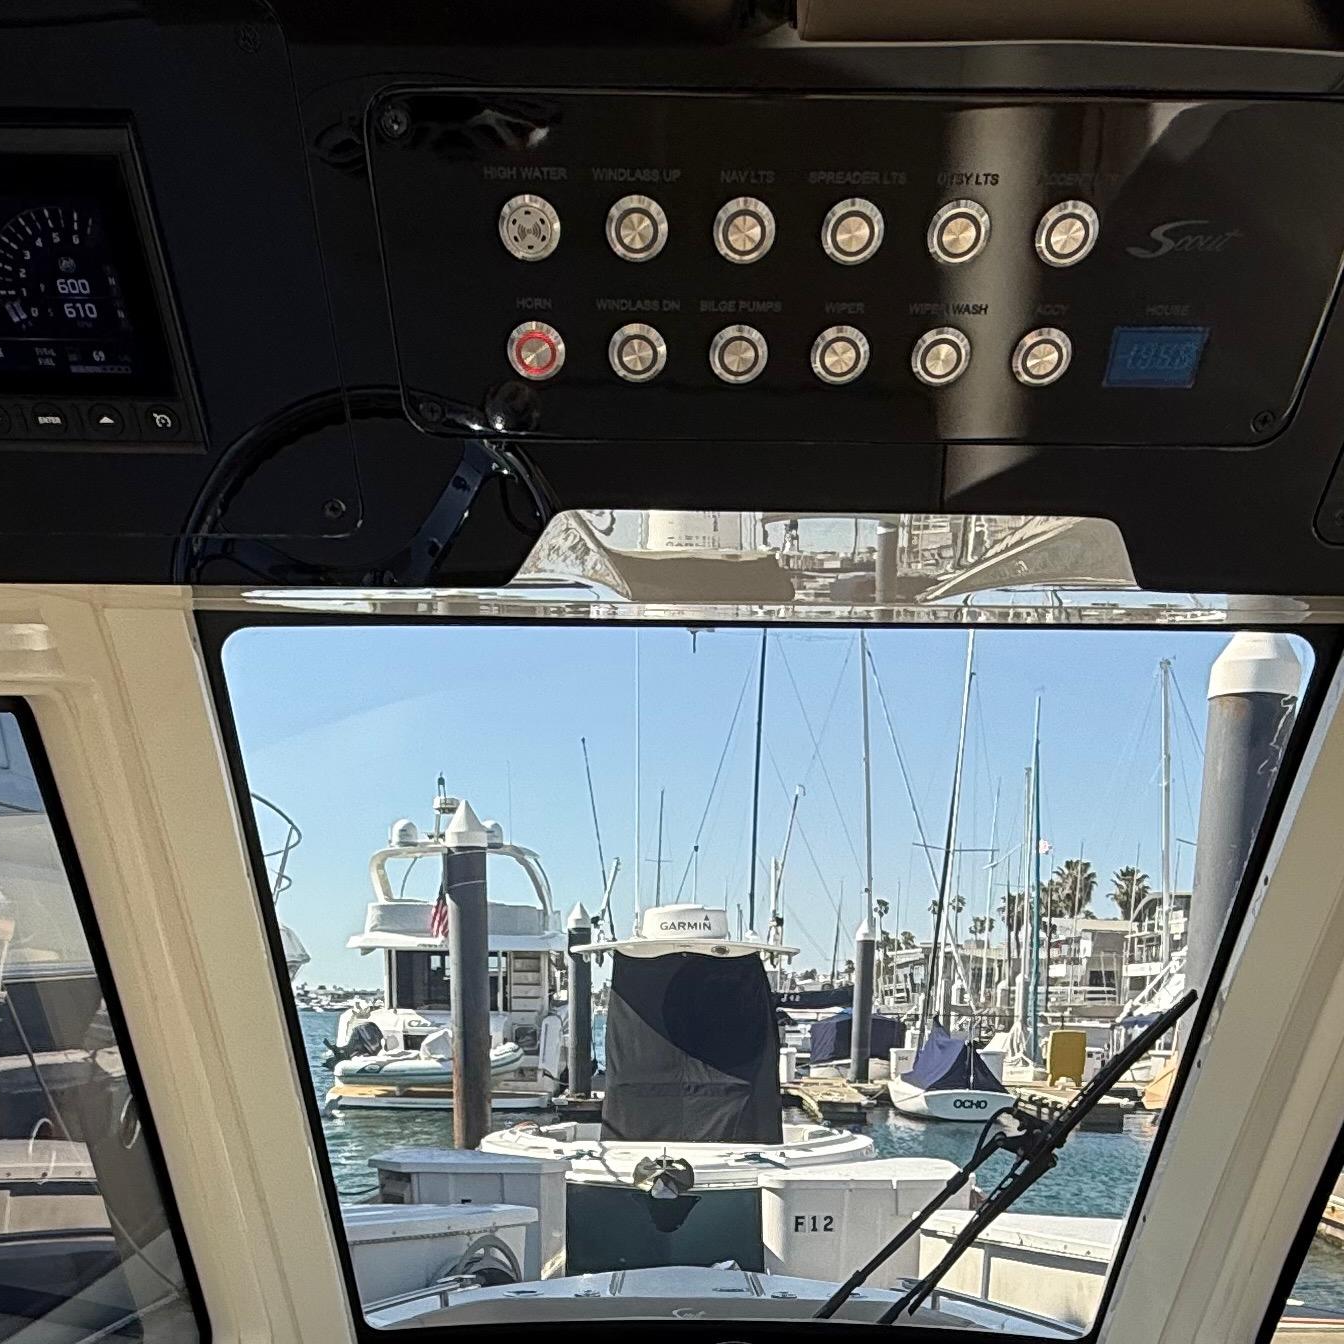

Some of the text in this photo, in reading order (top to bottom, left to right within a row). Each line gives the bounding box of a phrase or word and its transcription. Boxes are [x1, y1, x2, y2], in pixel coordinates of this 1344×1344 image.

[483, 166, 568, 180] HIGH WATER
[592, 167, 682, 182] WINDLASS UP
[720, 170, 776, 183] NAV LTS
[808, 171, 907, 185] SPREADER LTS
[974, 172, 1000, 186] LTS
[1125, 220, 1245, 259] Scout
[56, 278, 91, 295] 600
[63, 302, 98, 319] 610
[515, 297, 553, 310] HORN
[595, 298, 661, 312] WINDLASS
[699, 299, 783, 313] BILGE PUMPS
[824, 301, 865, 315] WIPER
[951, 303, 989, 316] WASH
[92, 349, 106, 362] 69
[659, 921, 712, 932] GARMIN
